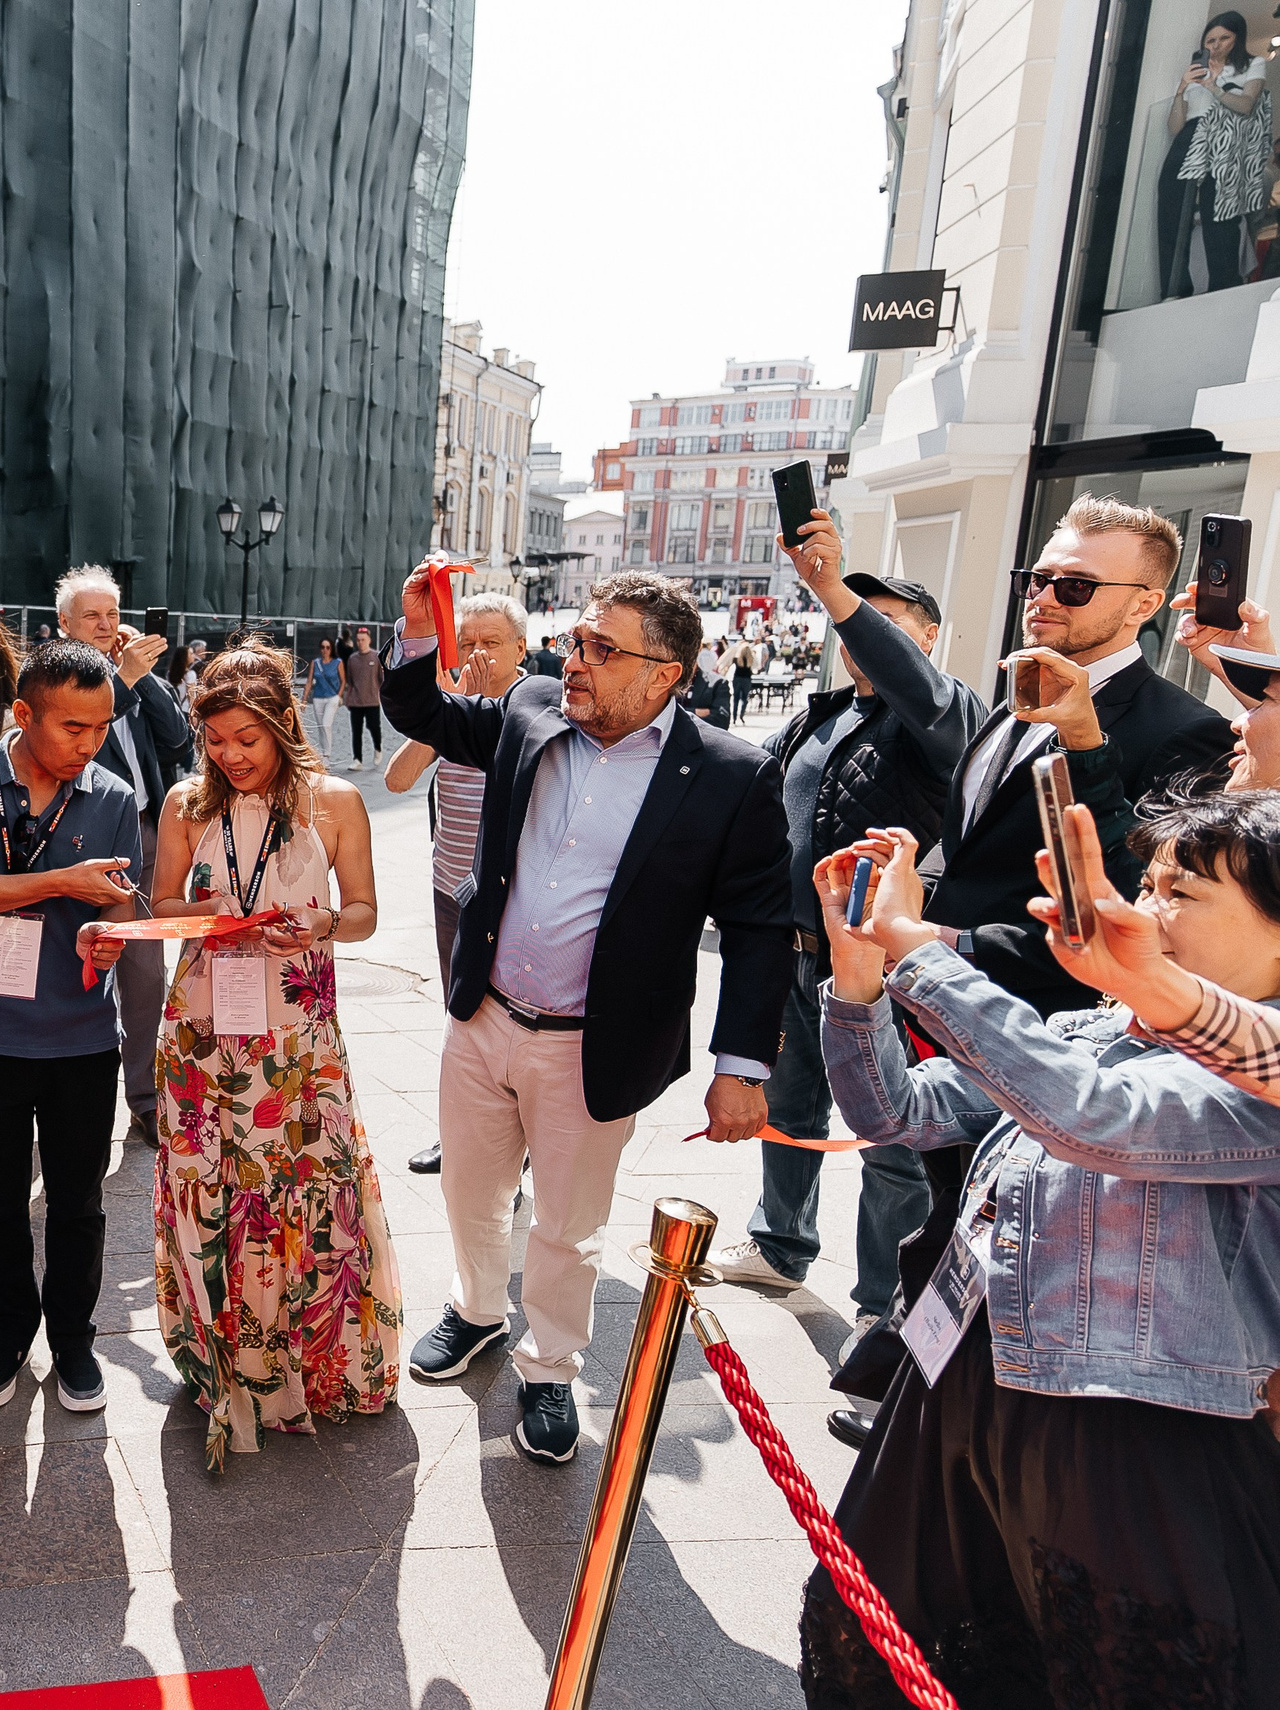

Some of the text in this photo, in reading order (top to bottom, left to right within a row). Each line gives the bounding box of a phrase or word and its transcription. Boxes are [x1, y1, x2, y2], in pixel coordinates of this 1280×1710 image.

[862, 298, 935, 322] MAAG
[827, 463, 848, 475] MA
[248, 871, 262, 903] HENDERSON
